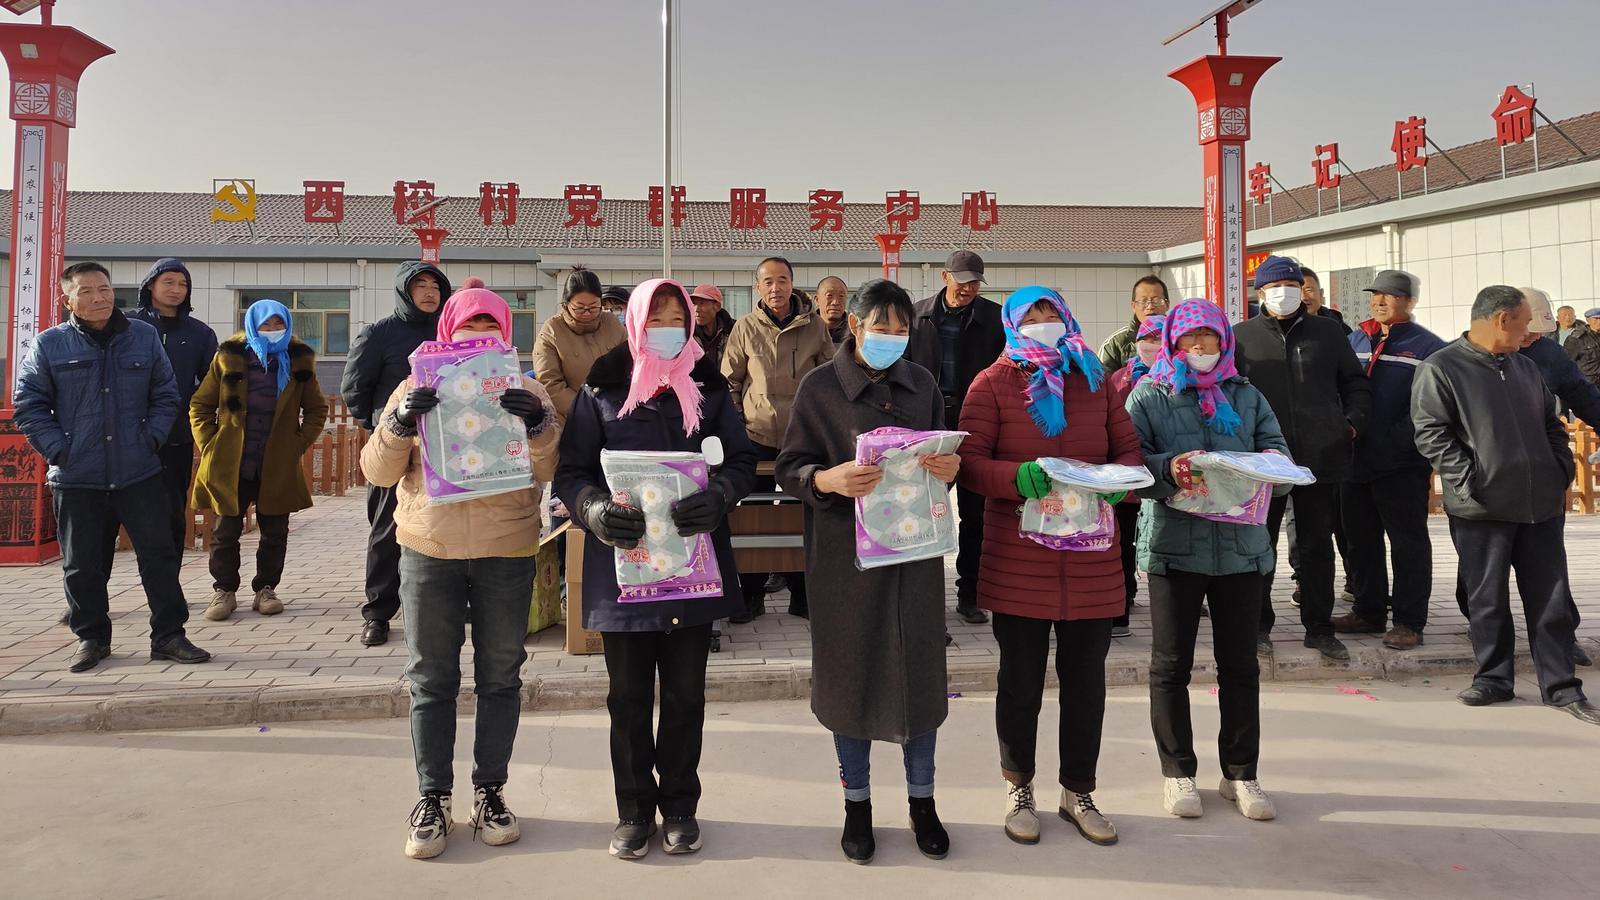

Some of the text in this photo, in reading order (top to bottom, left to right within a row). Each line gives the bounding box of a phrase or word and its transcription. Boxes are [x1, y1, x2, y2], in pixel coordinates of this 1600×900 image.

[1248, 86, 1536, 205] 牢记使命
[304, 181, 998, 230] 西校村党群服务中心
